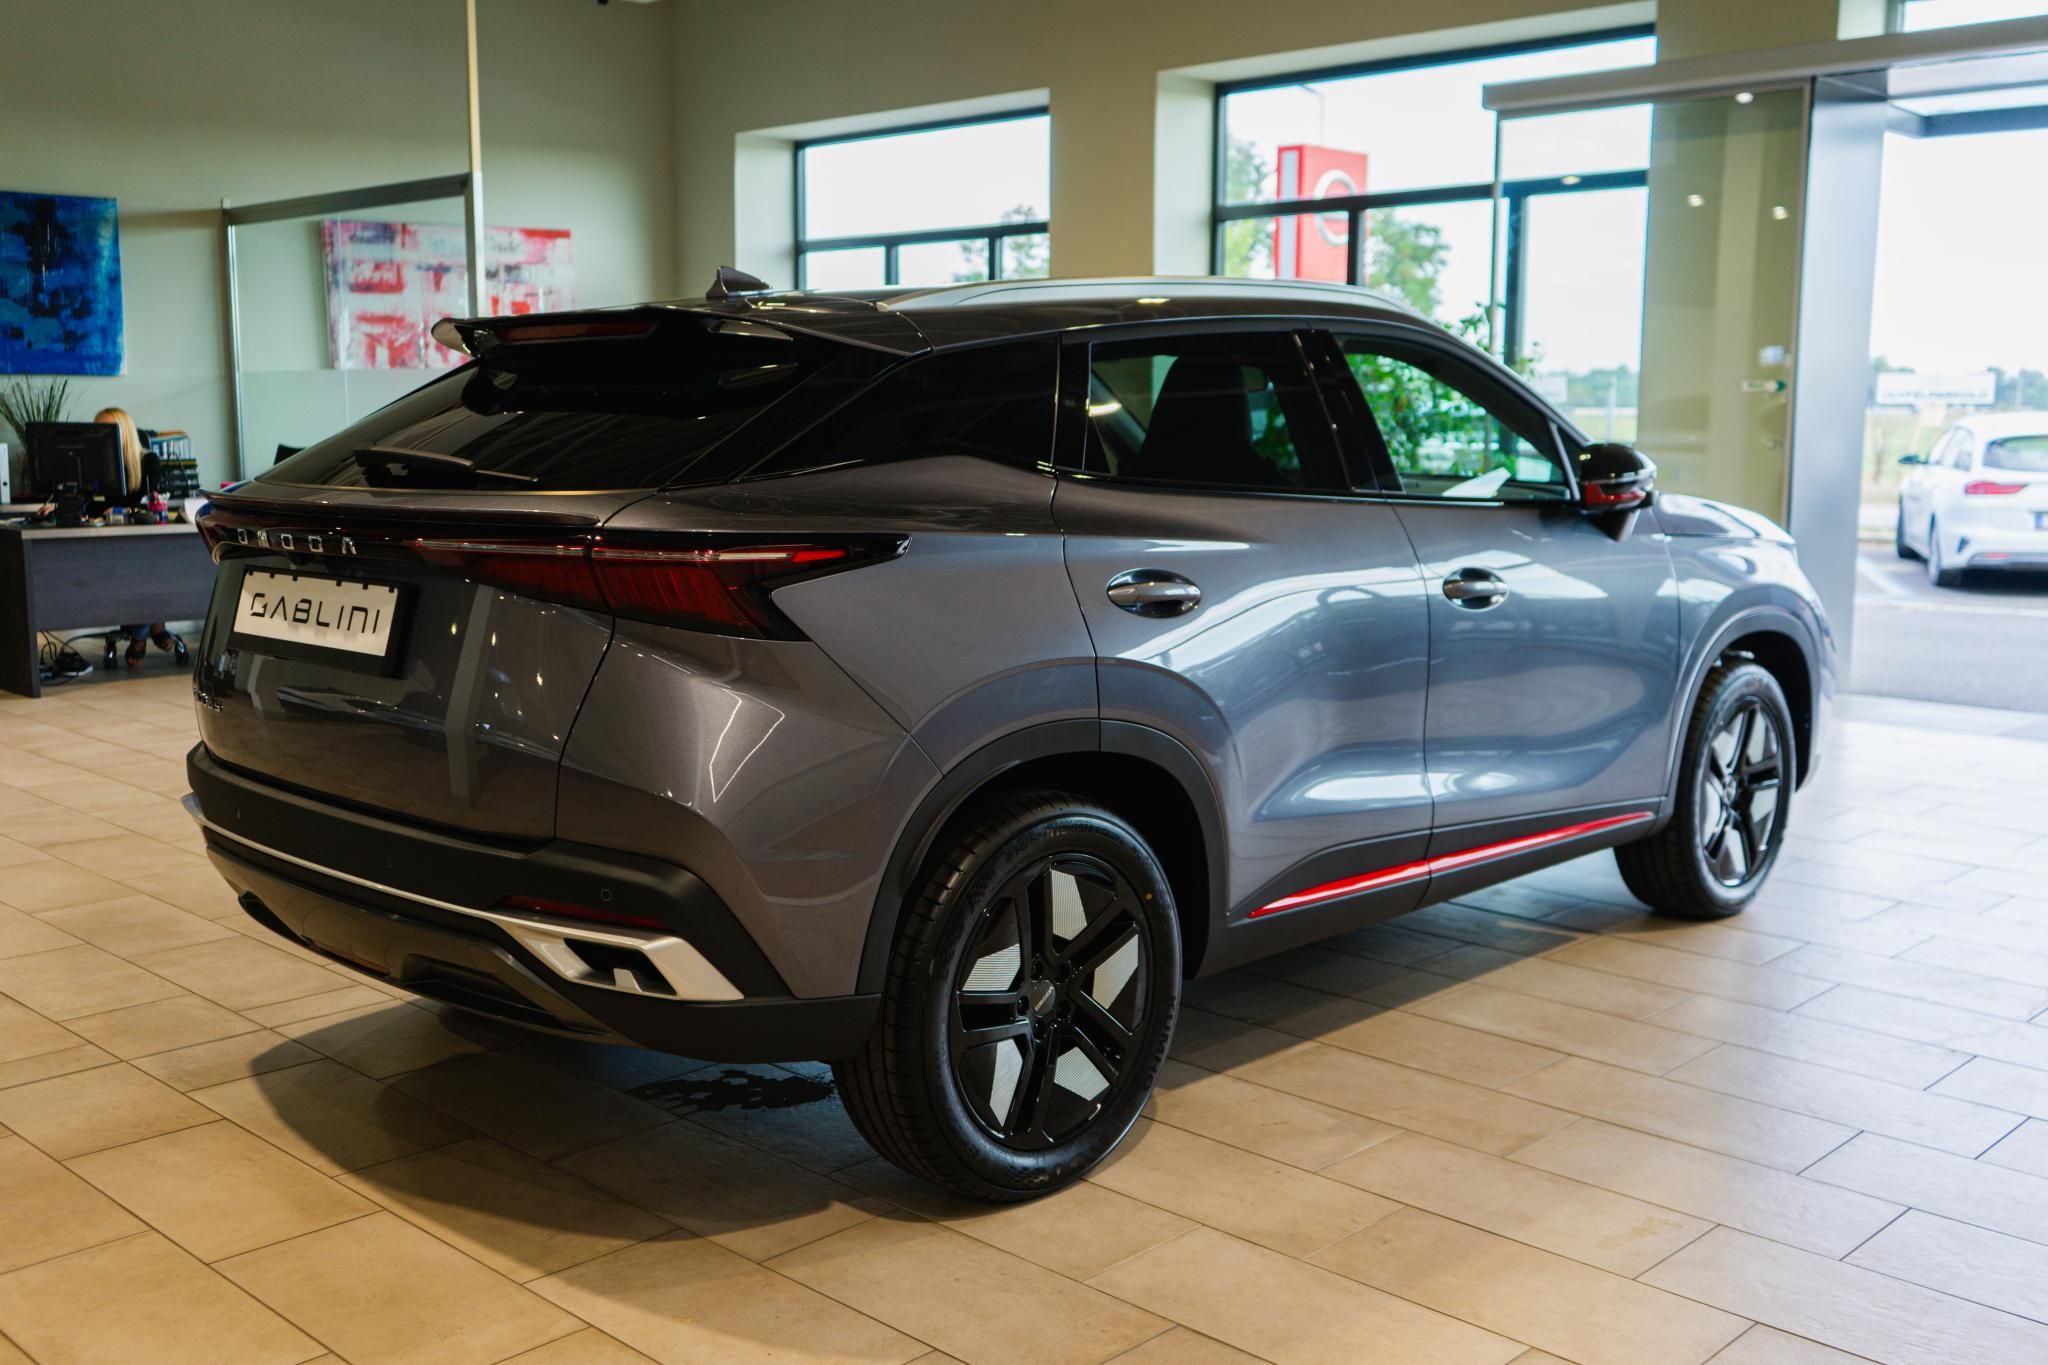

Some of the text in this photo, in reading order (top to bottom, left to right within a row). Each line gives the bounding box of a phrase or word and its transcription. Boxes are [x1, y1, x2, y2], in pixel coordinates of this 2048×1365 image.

[237, 528, 357, 555] OMODA
[250, 592, 380, 634] GABLINI
[1143, 995, 1176, 1091] KUMHO
